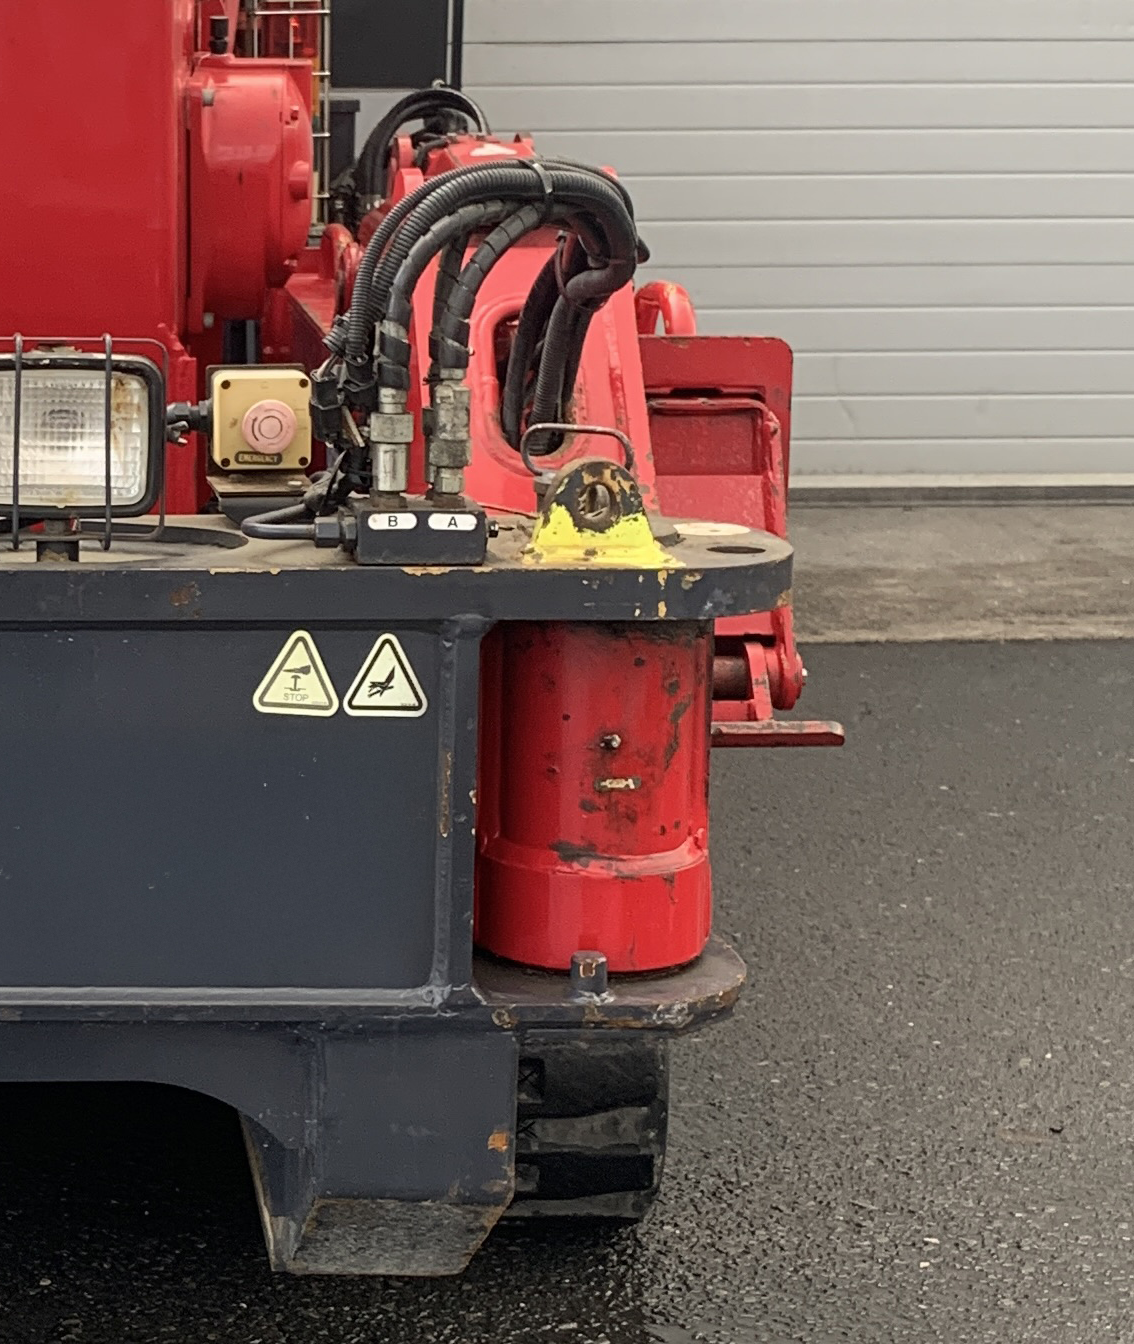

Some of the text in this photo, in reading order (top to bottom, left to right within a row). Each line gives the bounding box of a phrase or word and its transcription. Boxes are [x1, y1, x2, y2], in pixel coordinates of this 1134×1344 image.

[388, 515, 398, 527] B
[447, 516, 458, 528] A
[282, 692, 309, 702] STOP
